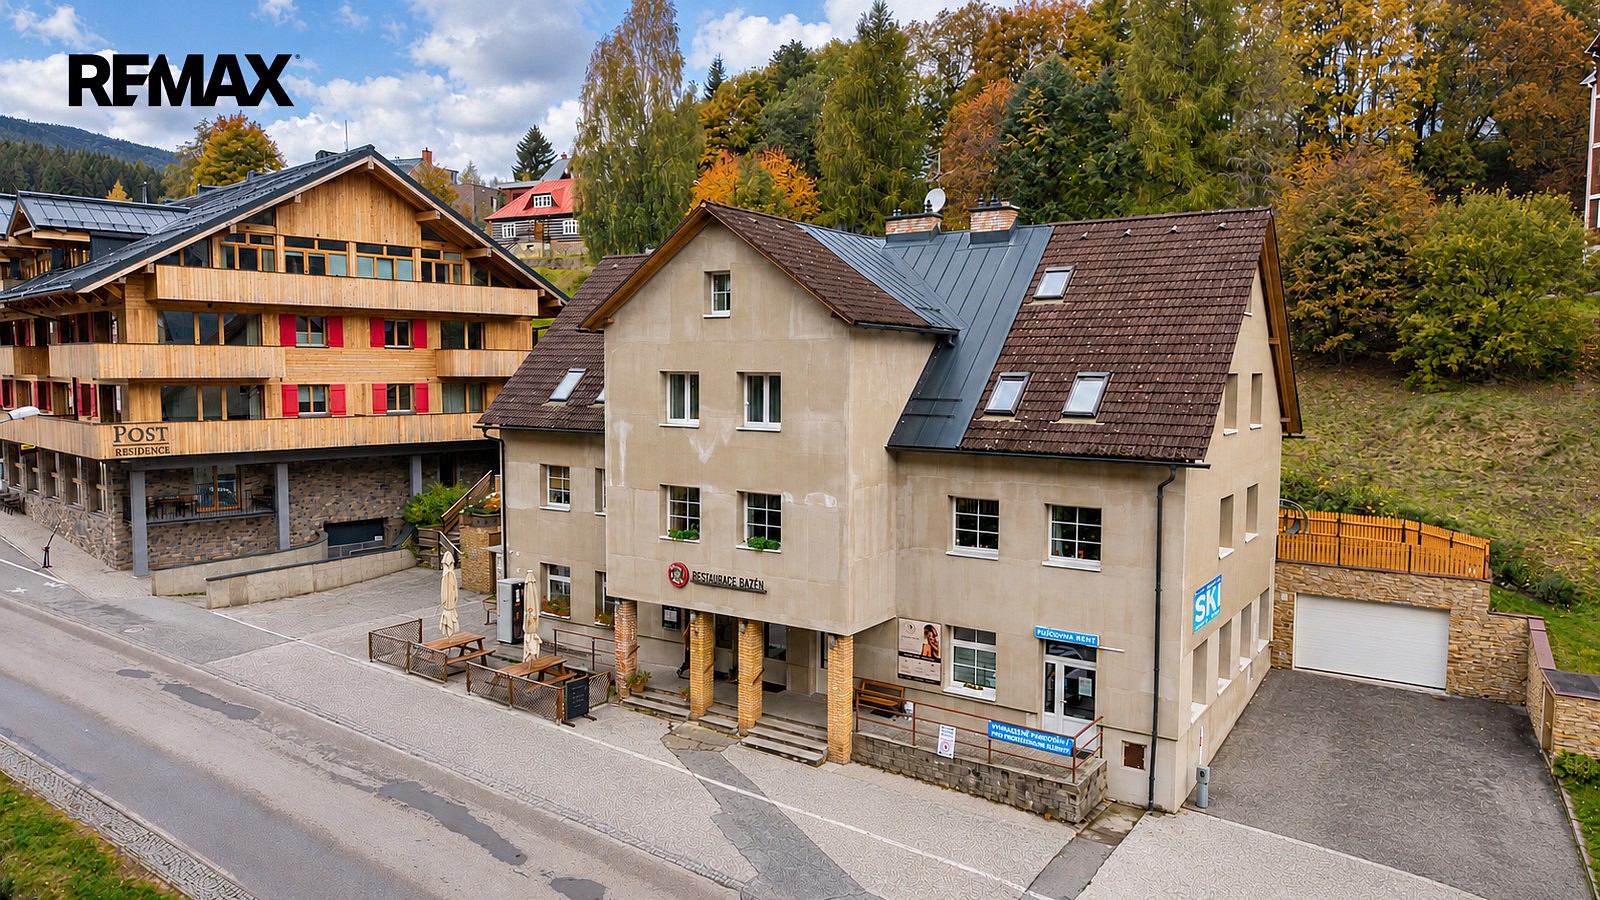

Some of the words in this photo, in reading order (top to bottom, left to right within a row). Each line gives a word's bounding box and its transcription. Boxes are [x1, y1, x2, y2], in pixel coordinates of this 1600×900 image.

[115, 446, 171, 456] RESIDENCE
[692, 571, 737, 587] RESTAURACE
[739, 577, 765, 590] BAZÉN
[1195, 582, 1221, 622] SKI
